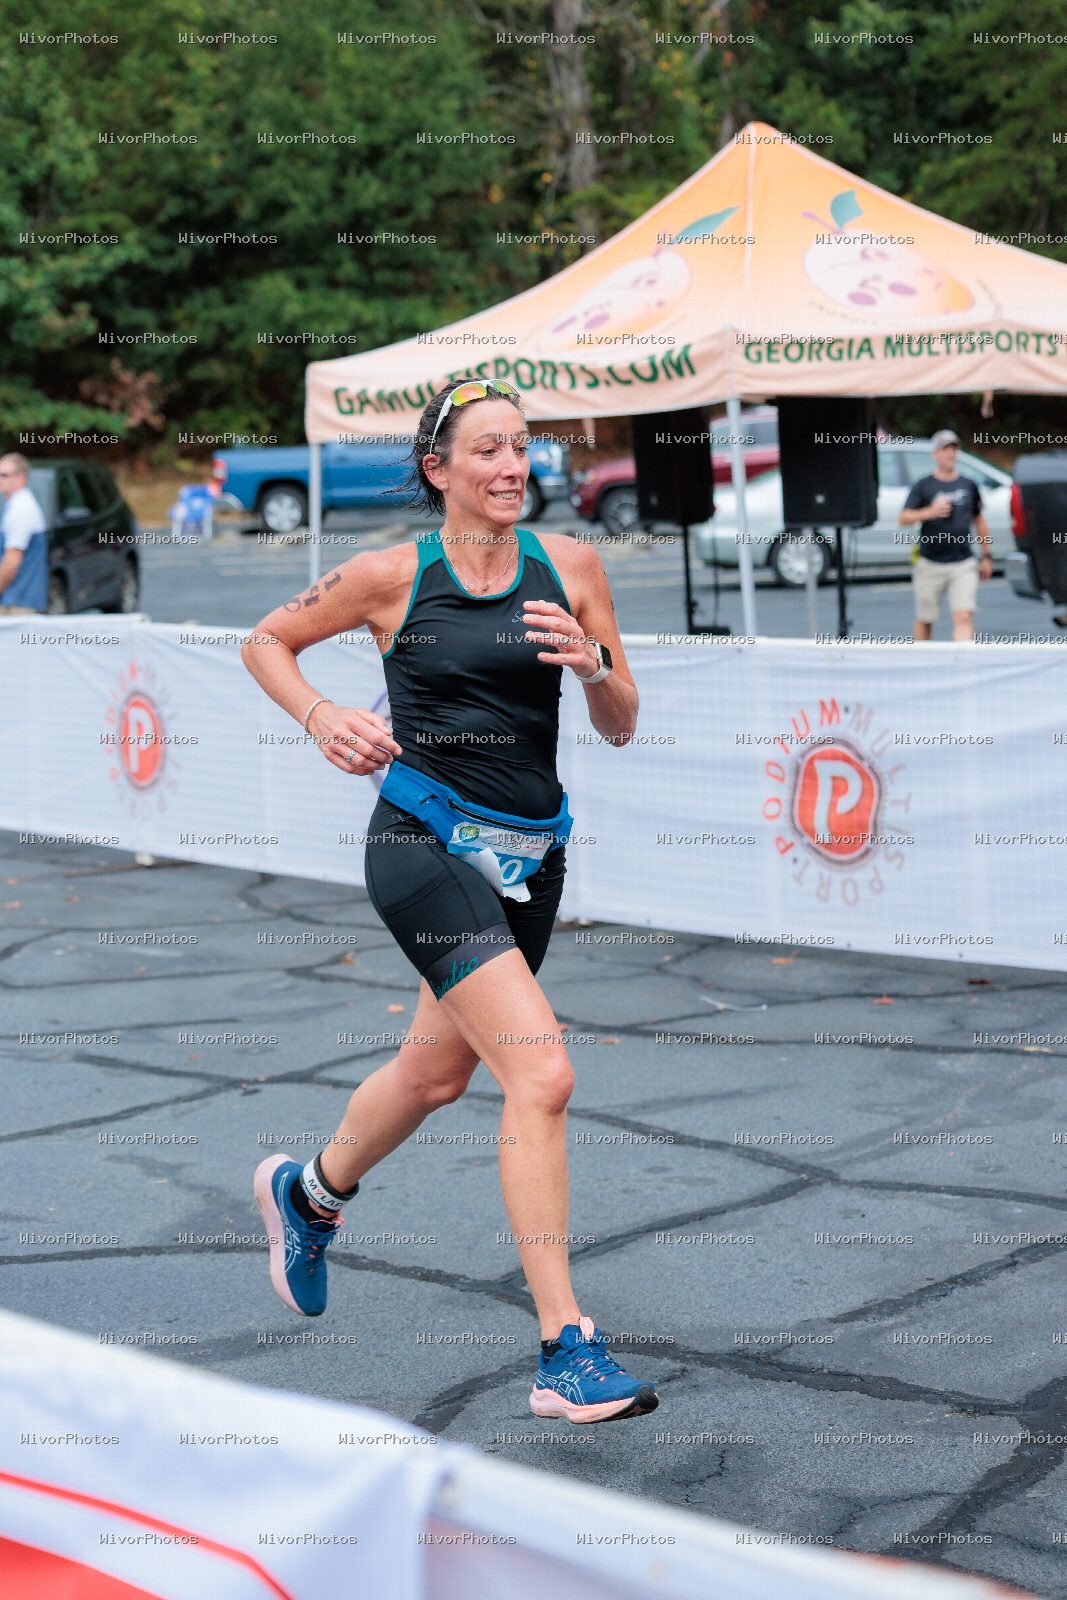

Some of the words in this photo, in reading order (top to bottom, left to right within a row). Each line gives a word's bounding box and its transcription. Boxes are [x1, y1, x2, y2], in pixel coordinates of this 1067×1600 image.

[744, 336, 875, 364] GEORGIA
[884, 329, 1058, 359] MULTISPORTS
[128, 707, 154, 774] P
[813, 760, 863, 850] P
